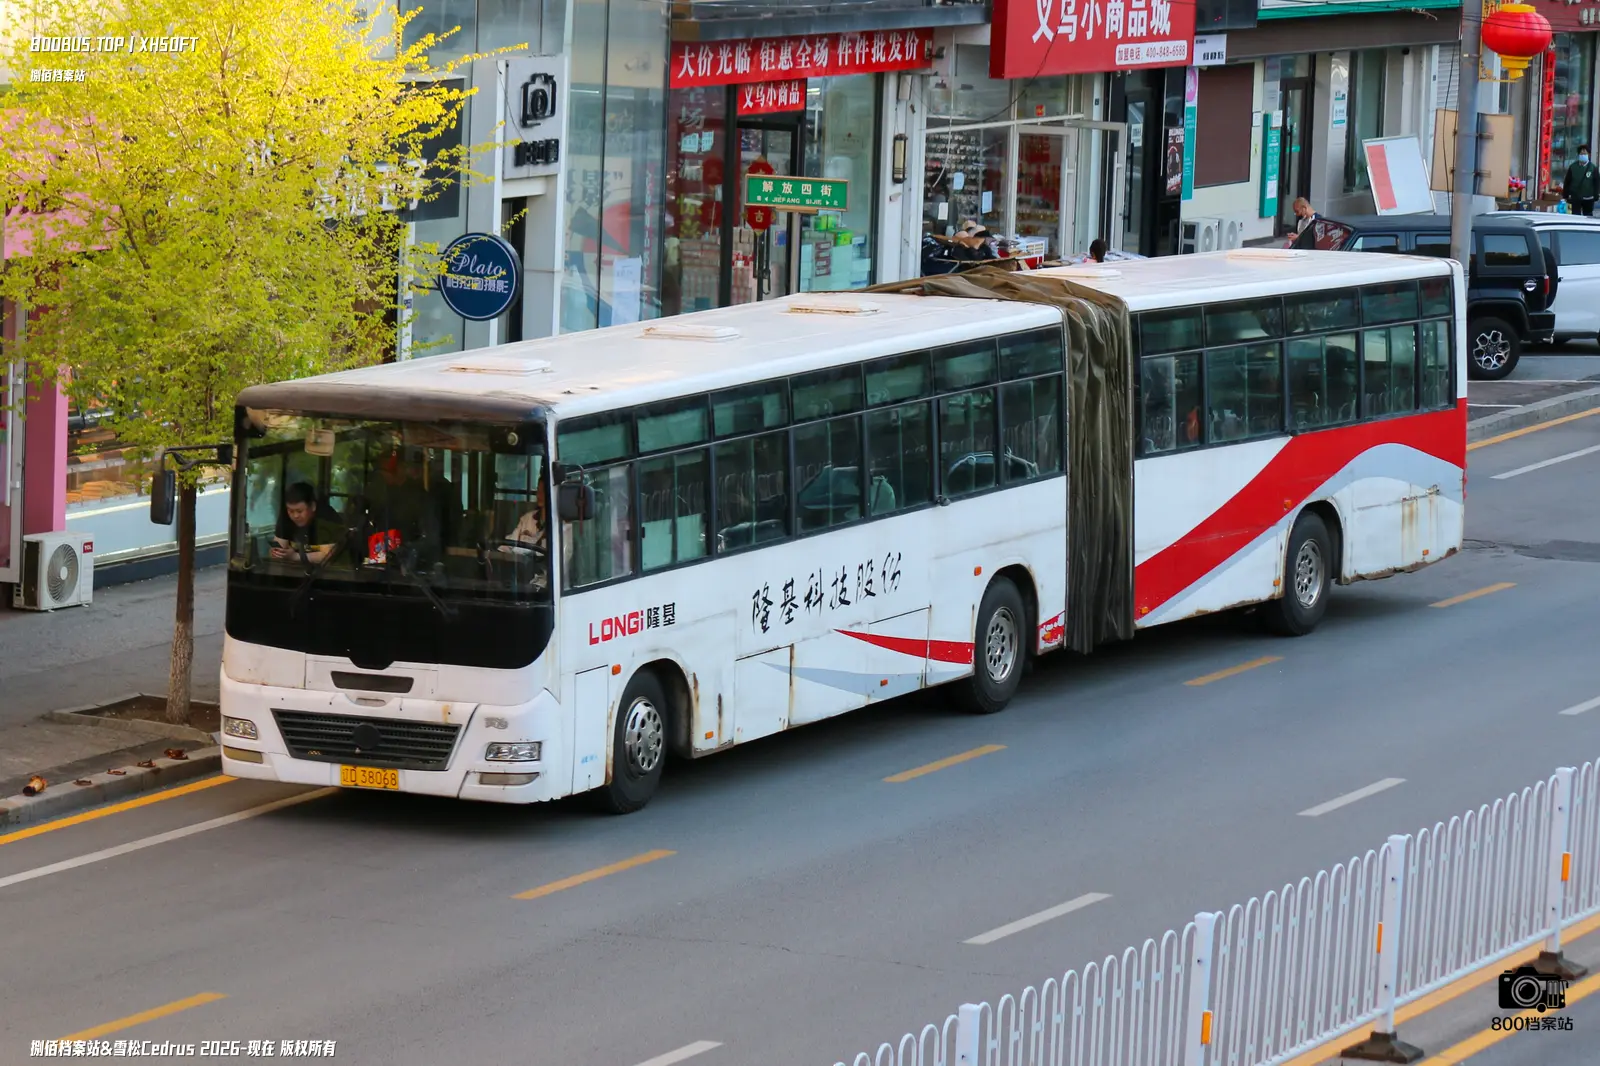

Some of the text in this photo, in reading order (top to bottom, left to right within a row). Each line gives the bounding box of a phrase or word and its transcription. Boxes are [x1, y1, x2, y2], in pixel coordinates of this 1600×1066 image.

[1031, 0, 1171, 44] 义乌小商品城
[759, 37, 829, 72] 钜惠全场
[837, 31, 920, 67] 件件批发价
[742, 78, 800, 110] 义乌小商品
[762, 180, 832, 197] 解放四街
[452, 252, 503, 276] Plato
[752, 552, 902, 635] 隆基科技股份
[646, 602, 676, 630] 隆基
